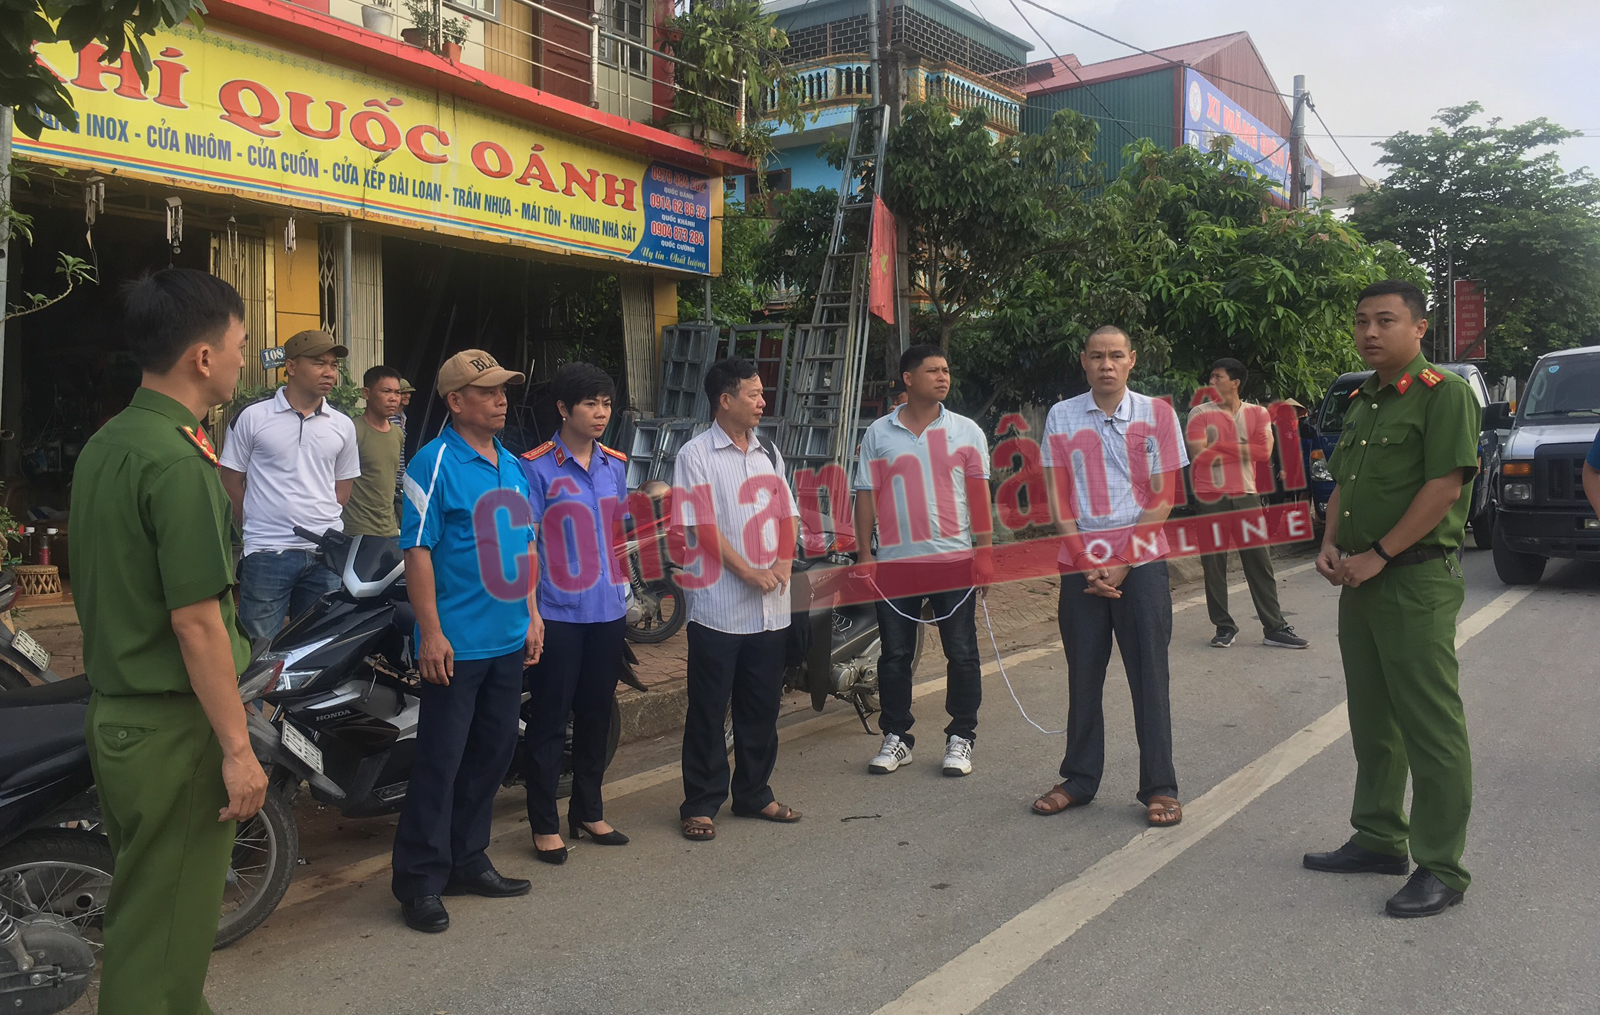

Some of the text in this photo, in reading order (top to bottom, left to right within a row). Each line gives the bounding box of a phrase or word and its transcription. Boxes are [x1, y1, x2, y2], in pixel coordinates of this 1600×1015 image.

[217, 78, 451, 165] QUỐC
[1206, 92, 1221, 126] XI
[1223, 104, 1258, 152] MĂNG
[86, 112, 129, 143] INOX
[146, 118, 180, 153] CỬA
[185, 132, 232, 162] NHÔM
[247, 138, 277, 170] CỬA
[280, 149, 319, 178] CUỐN
[332, 156, 359, 186] CỬA
[363, 163, 386, 191] XẾP
[388, 172, 409, 196] ĐÀI
[412, 178, 442, 202] LOAN
[452, 184, 482, 210] TRẦN
[484, 193, 512, 219] NHỰA
[521, 201, 541, 223] MÁI
[543, 205, 561, 227] TÔN
[570, 213, 600, 236] KHUNG
[602, 219, 620, 239] NHÀ
[621, 220, 637, 243] SẮT
[651, 165, 672, 185] 0979
[650, 193, 671, 211] 0914
[672, 198, 683, 215] 62
[696, 205, 706, 221] 32
[651, 220, 705, 247] 0904 873 284
[315, 709, 352, 722] HONDA
